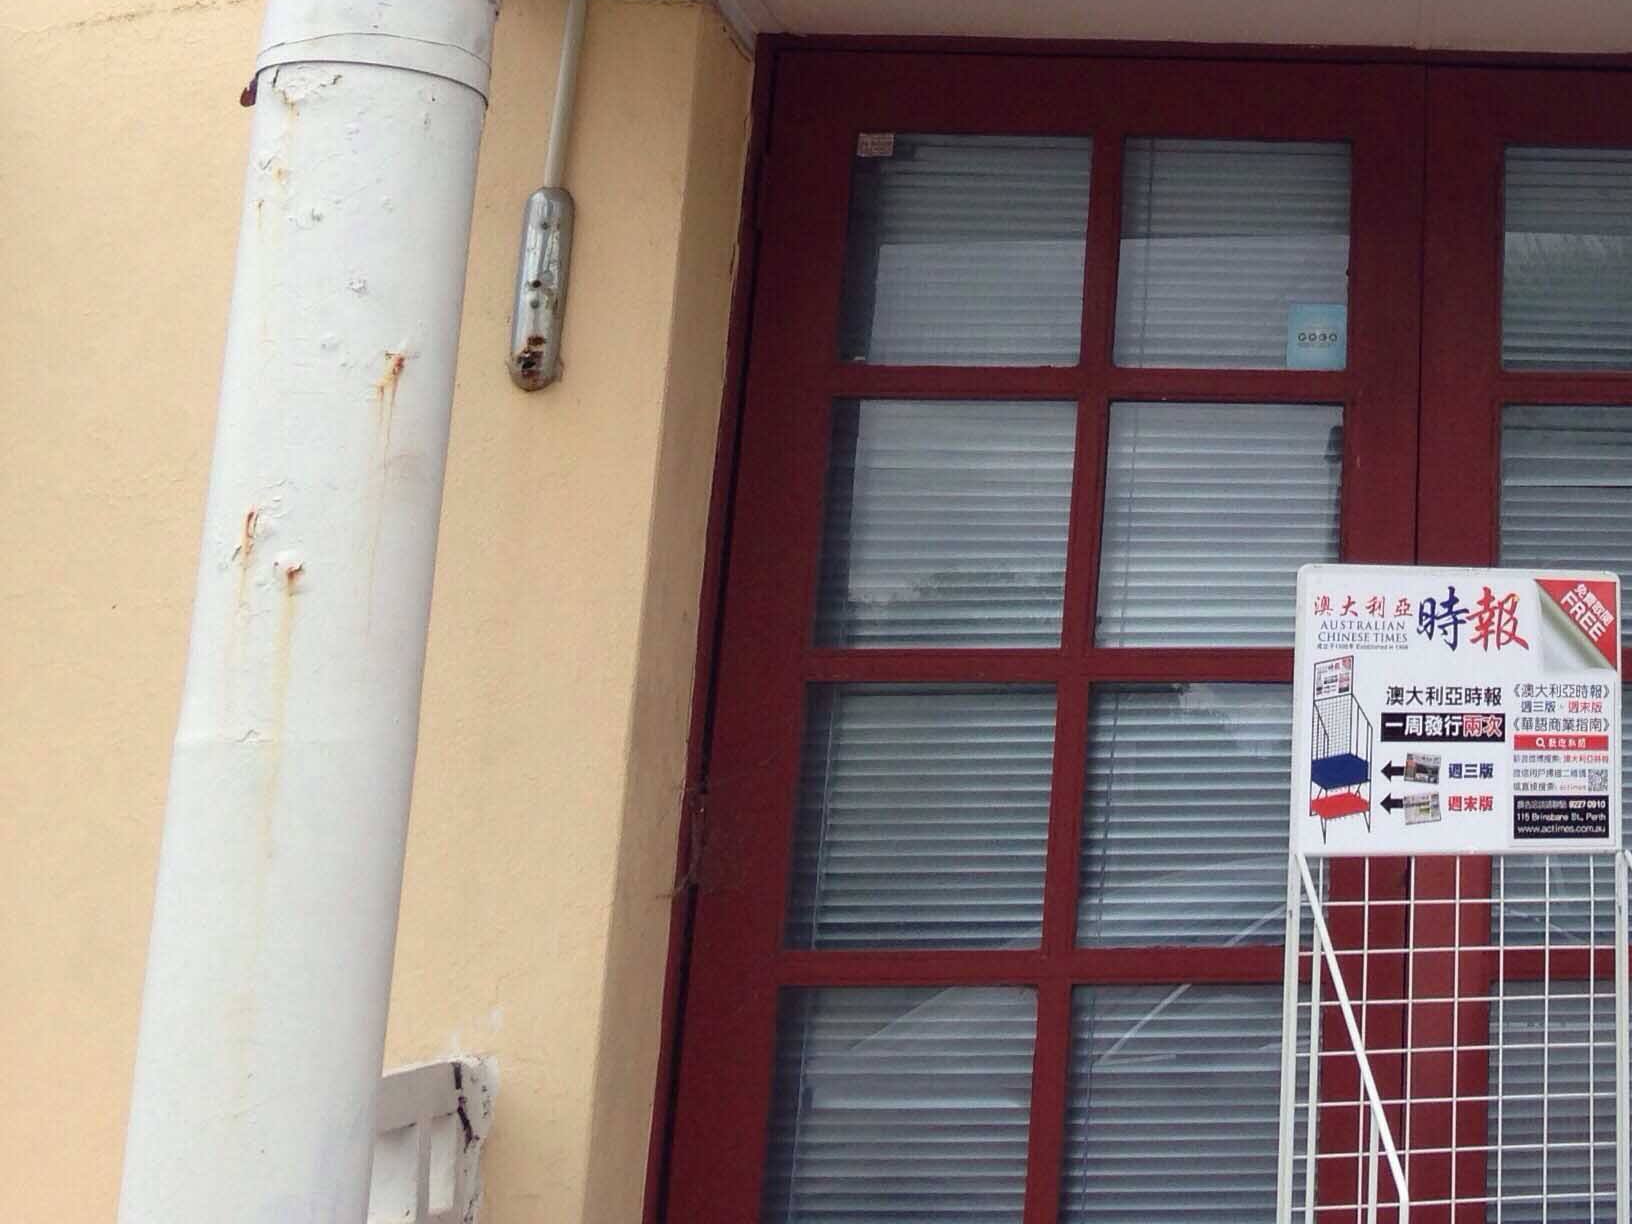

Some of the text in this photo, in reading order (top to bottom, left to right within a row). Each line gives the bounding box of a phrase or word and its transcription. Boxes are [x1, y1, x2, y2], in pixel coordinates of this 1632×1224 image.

[1560, 590, 1607, 642] FREE
[1320, 619, 1405, 631] AUSTRALIAN
[1318, 631, 1408, 643] CHINESE TIMES
[1386, 686, 1502, 706] 澳大利亞時報
[1385, 714, 1503, 738] 一周發行兩次
[1448, 762, 1494, 779] 週三版
[1448, 794, 1494, 812] 週末版
[1586, 811, 1607, 822] Perth
[1517, 824, 1607, 834] www.actimes.com.au
